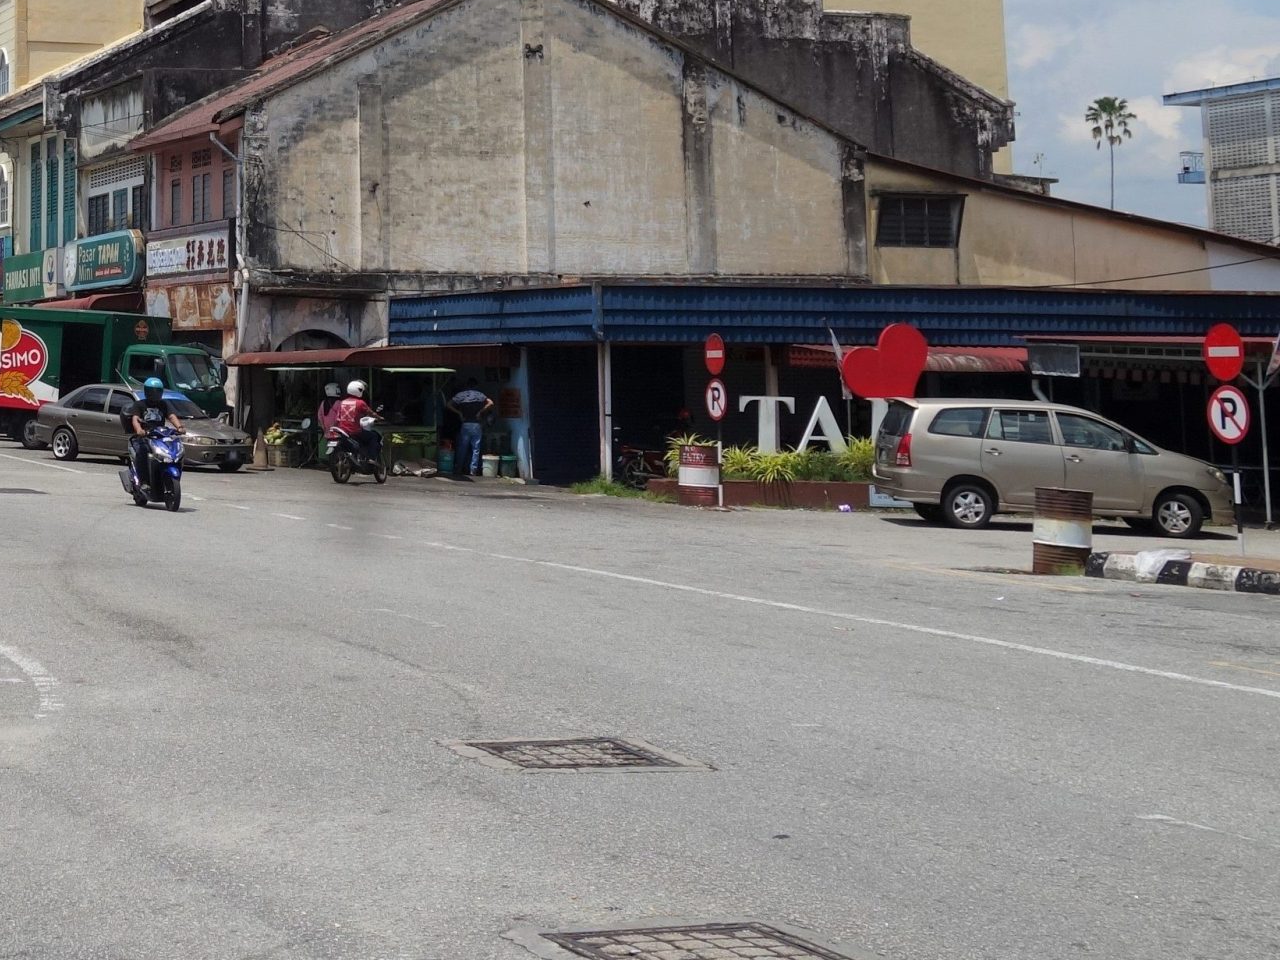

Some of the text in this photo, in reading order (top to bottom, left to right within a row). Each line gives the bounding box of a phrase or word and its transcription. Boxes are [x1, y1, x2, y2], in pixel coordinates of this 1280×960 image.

[78, 246, 96, 263] Pasar
[5, 269, 29, 290] FARMASI
[78, 263, 93, 281] Mini
